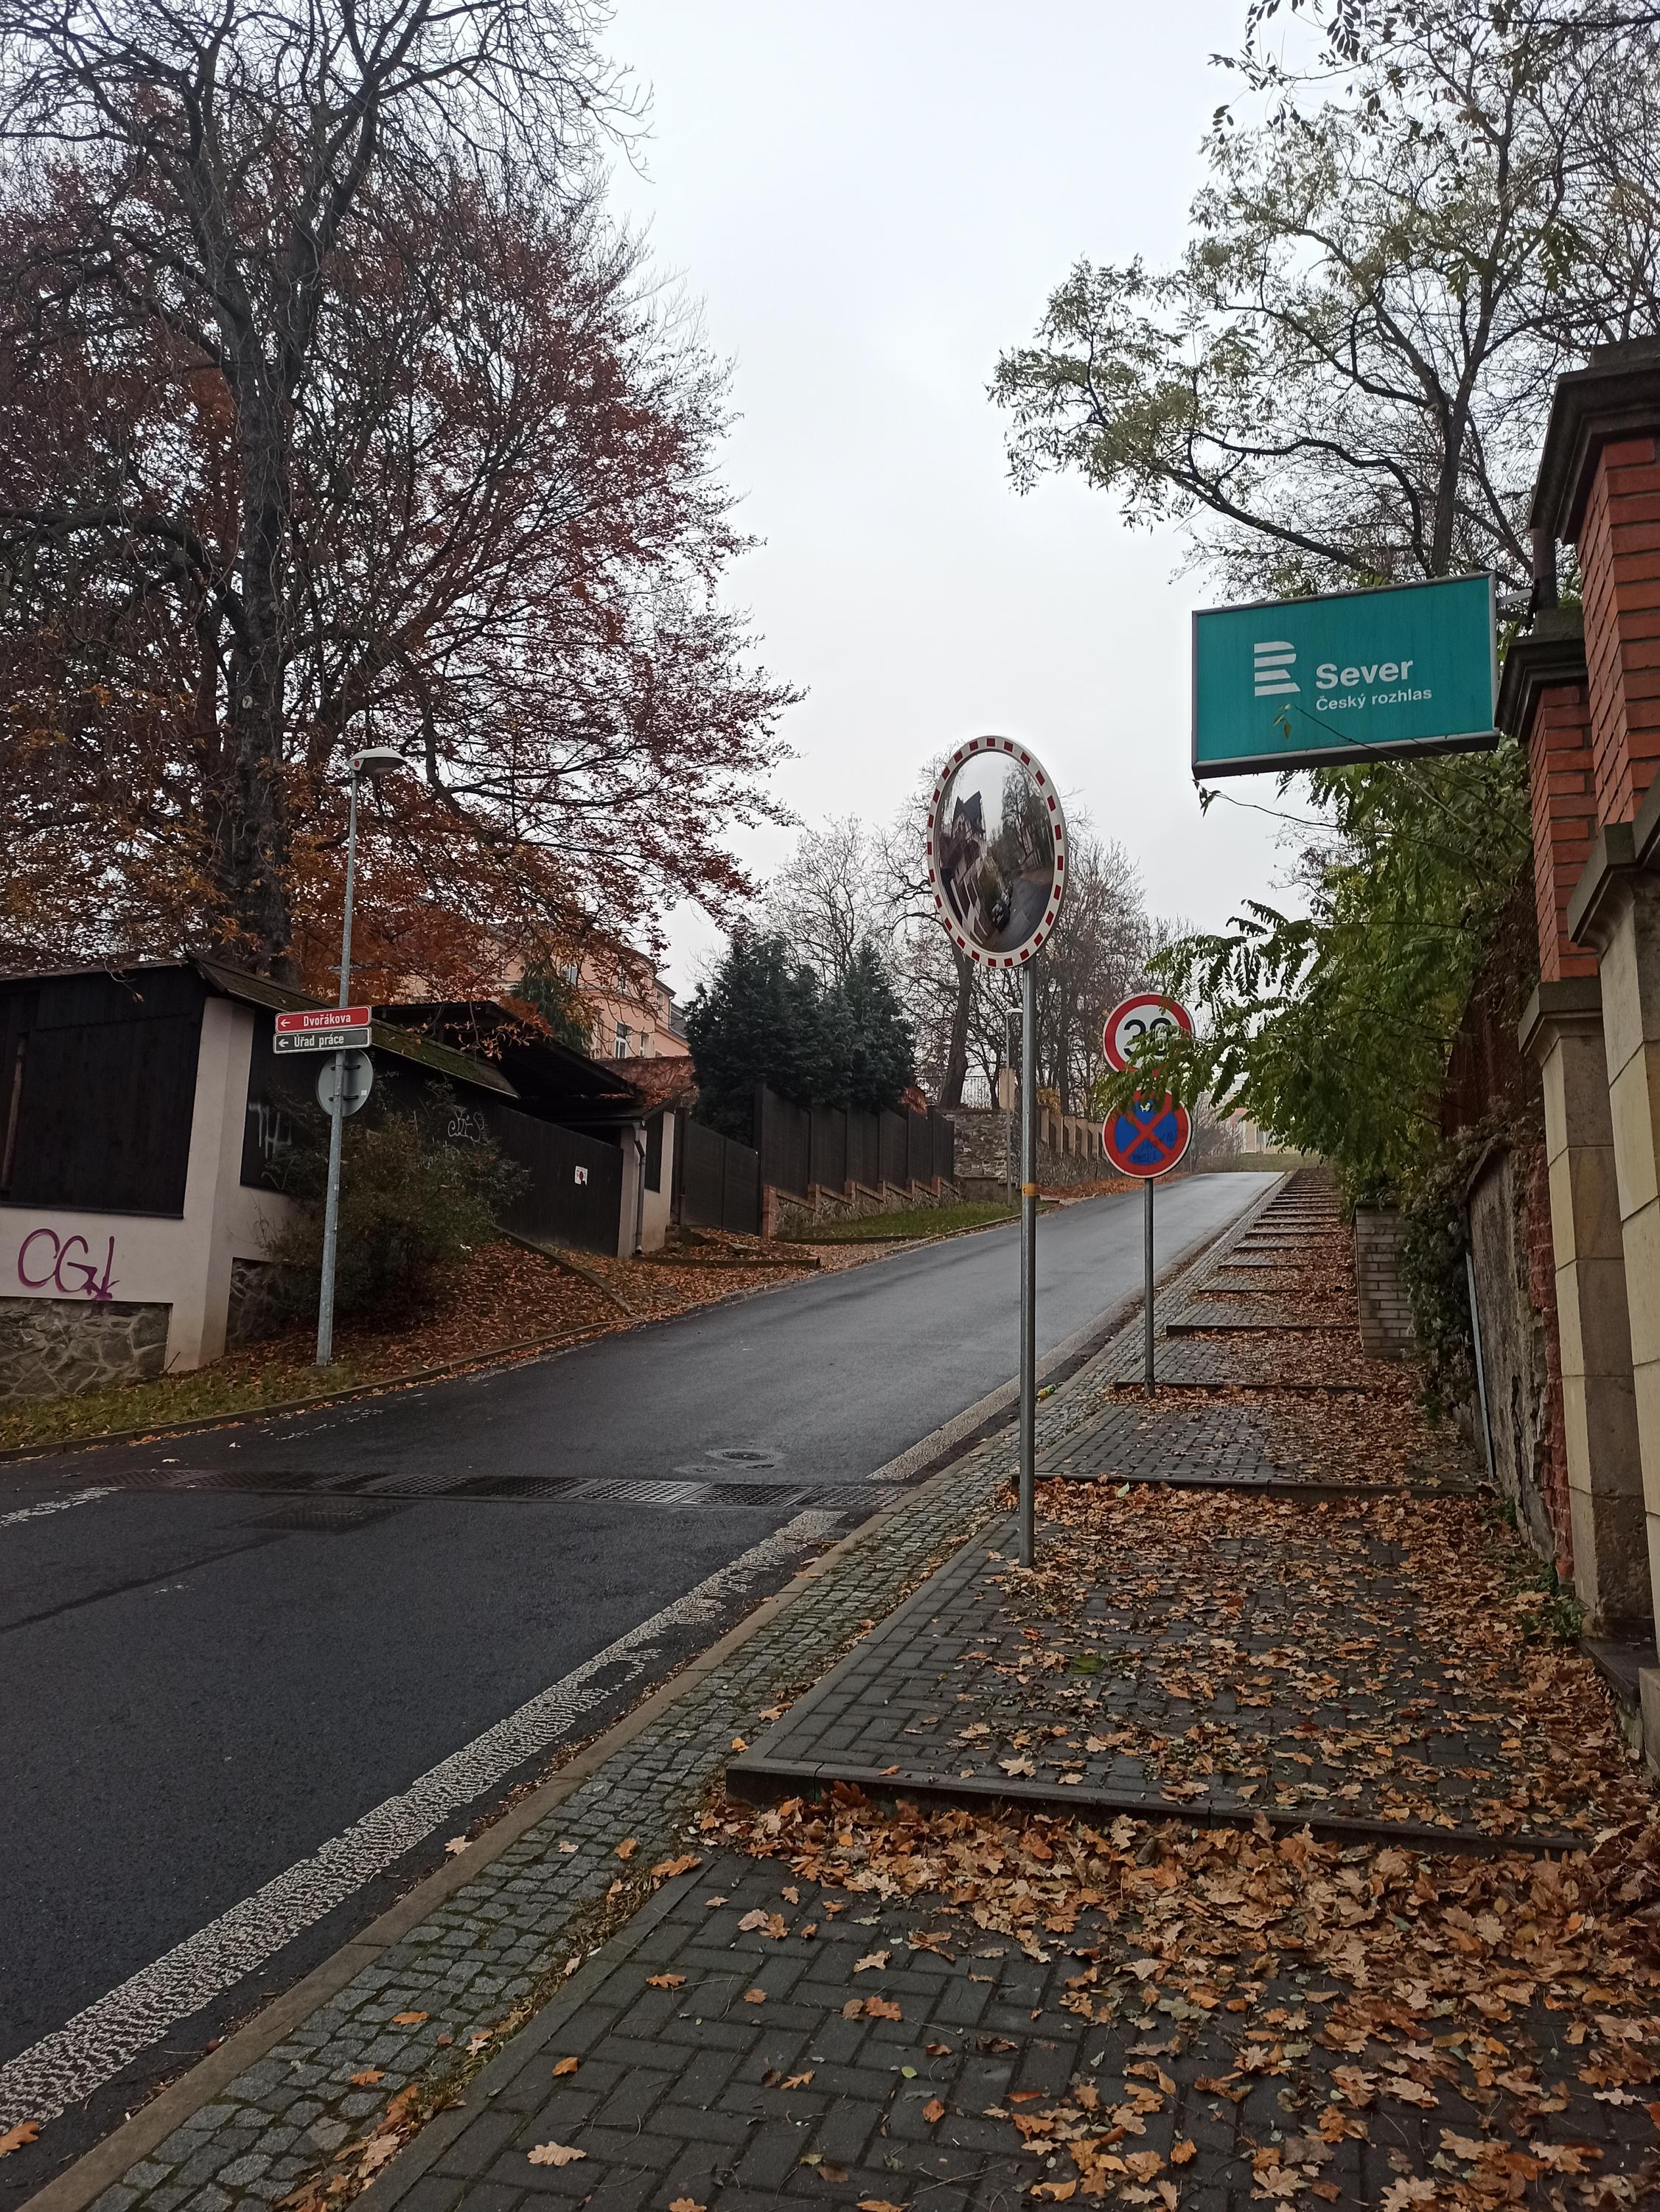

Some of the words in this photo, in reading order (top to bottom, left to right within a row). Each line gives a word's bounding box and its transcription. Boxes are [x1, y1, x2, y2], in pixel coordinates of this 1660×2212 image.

[1315, 660, 1413, 689] Sever
[1315, 694, 1366, 711] Český
[1371, 688, 1432, 705] rozhlas
[303, 1013, 351, 1027] Dvořákova
[294, 1034, 315, 1048] Úřad
[318, 1032, 344, 1048] práce
